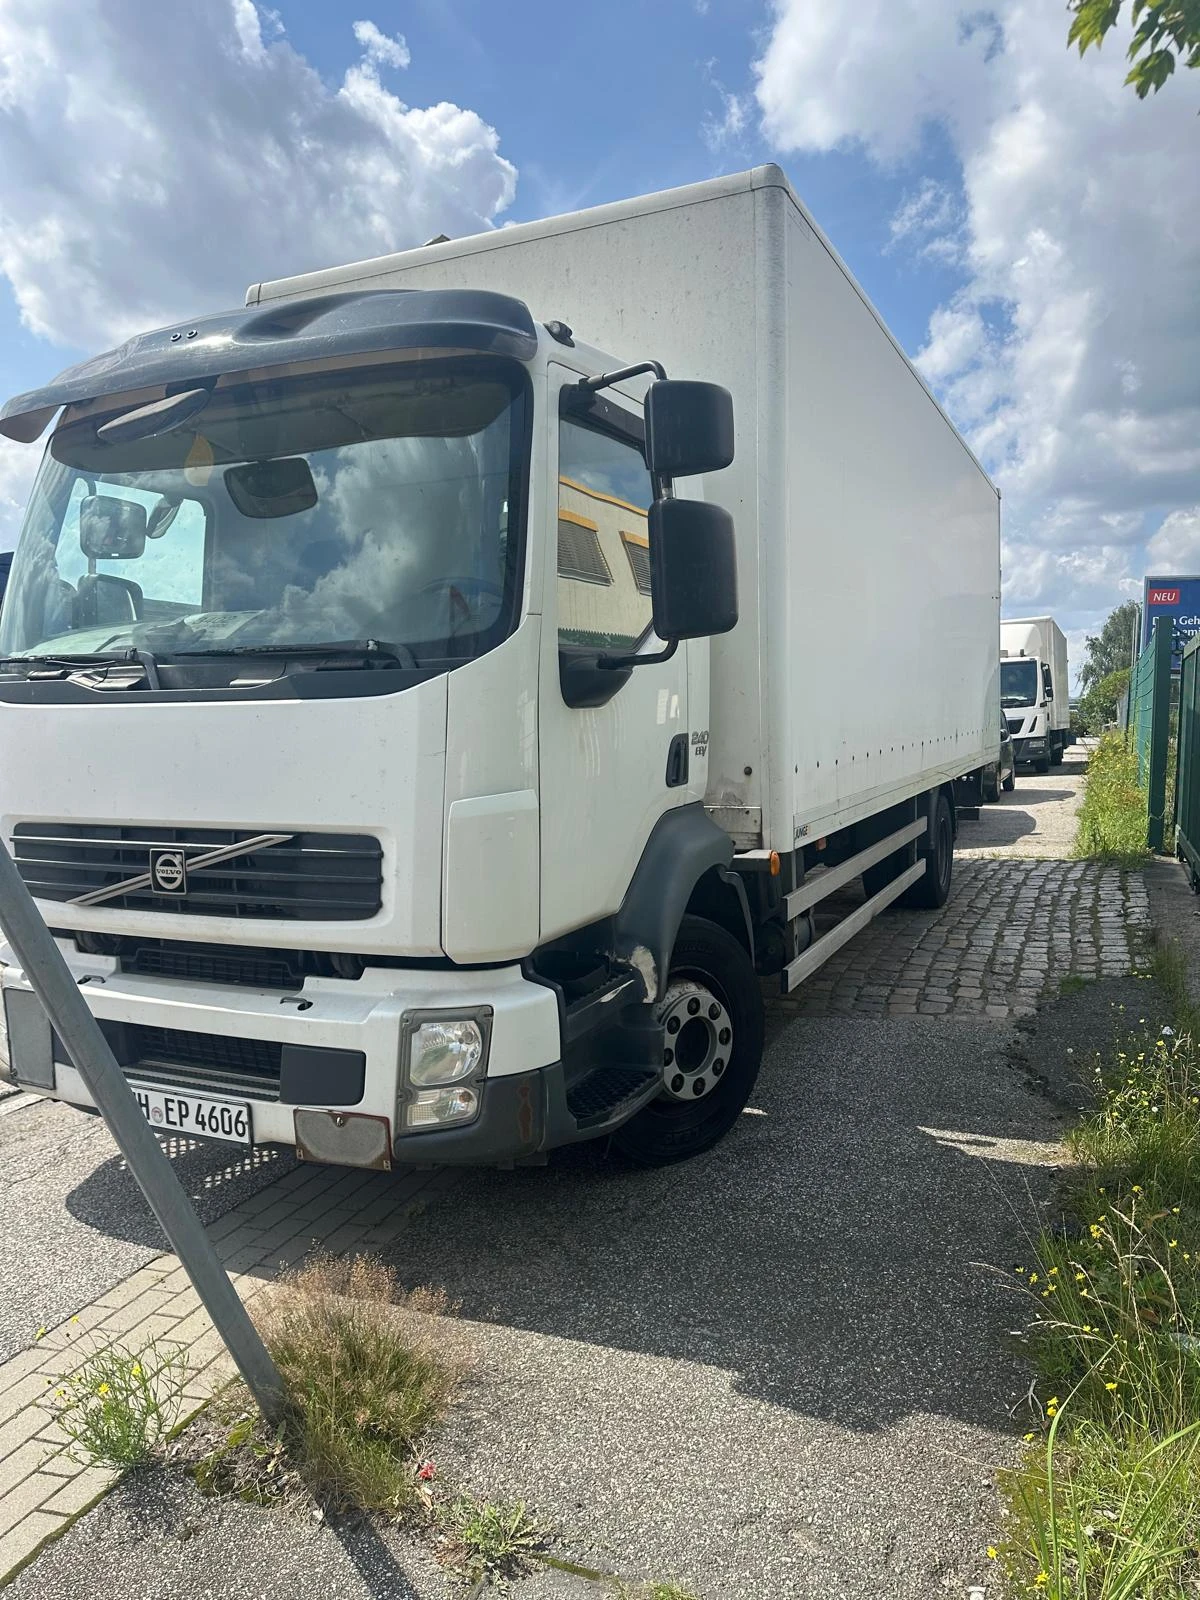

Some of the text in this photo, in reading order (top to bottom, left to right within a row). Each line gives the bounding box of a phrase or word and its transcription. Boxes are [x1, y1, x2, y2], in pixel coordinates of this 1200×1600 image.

[1153, 592, 1176, 601] NEU
[156, 868, 182, 876] VOLVO
[132, 1091, 246, 1138] H EP 4606
